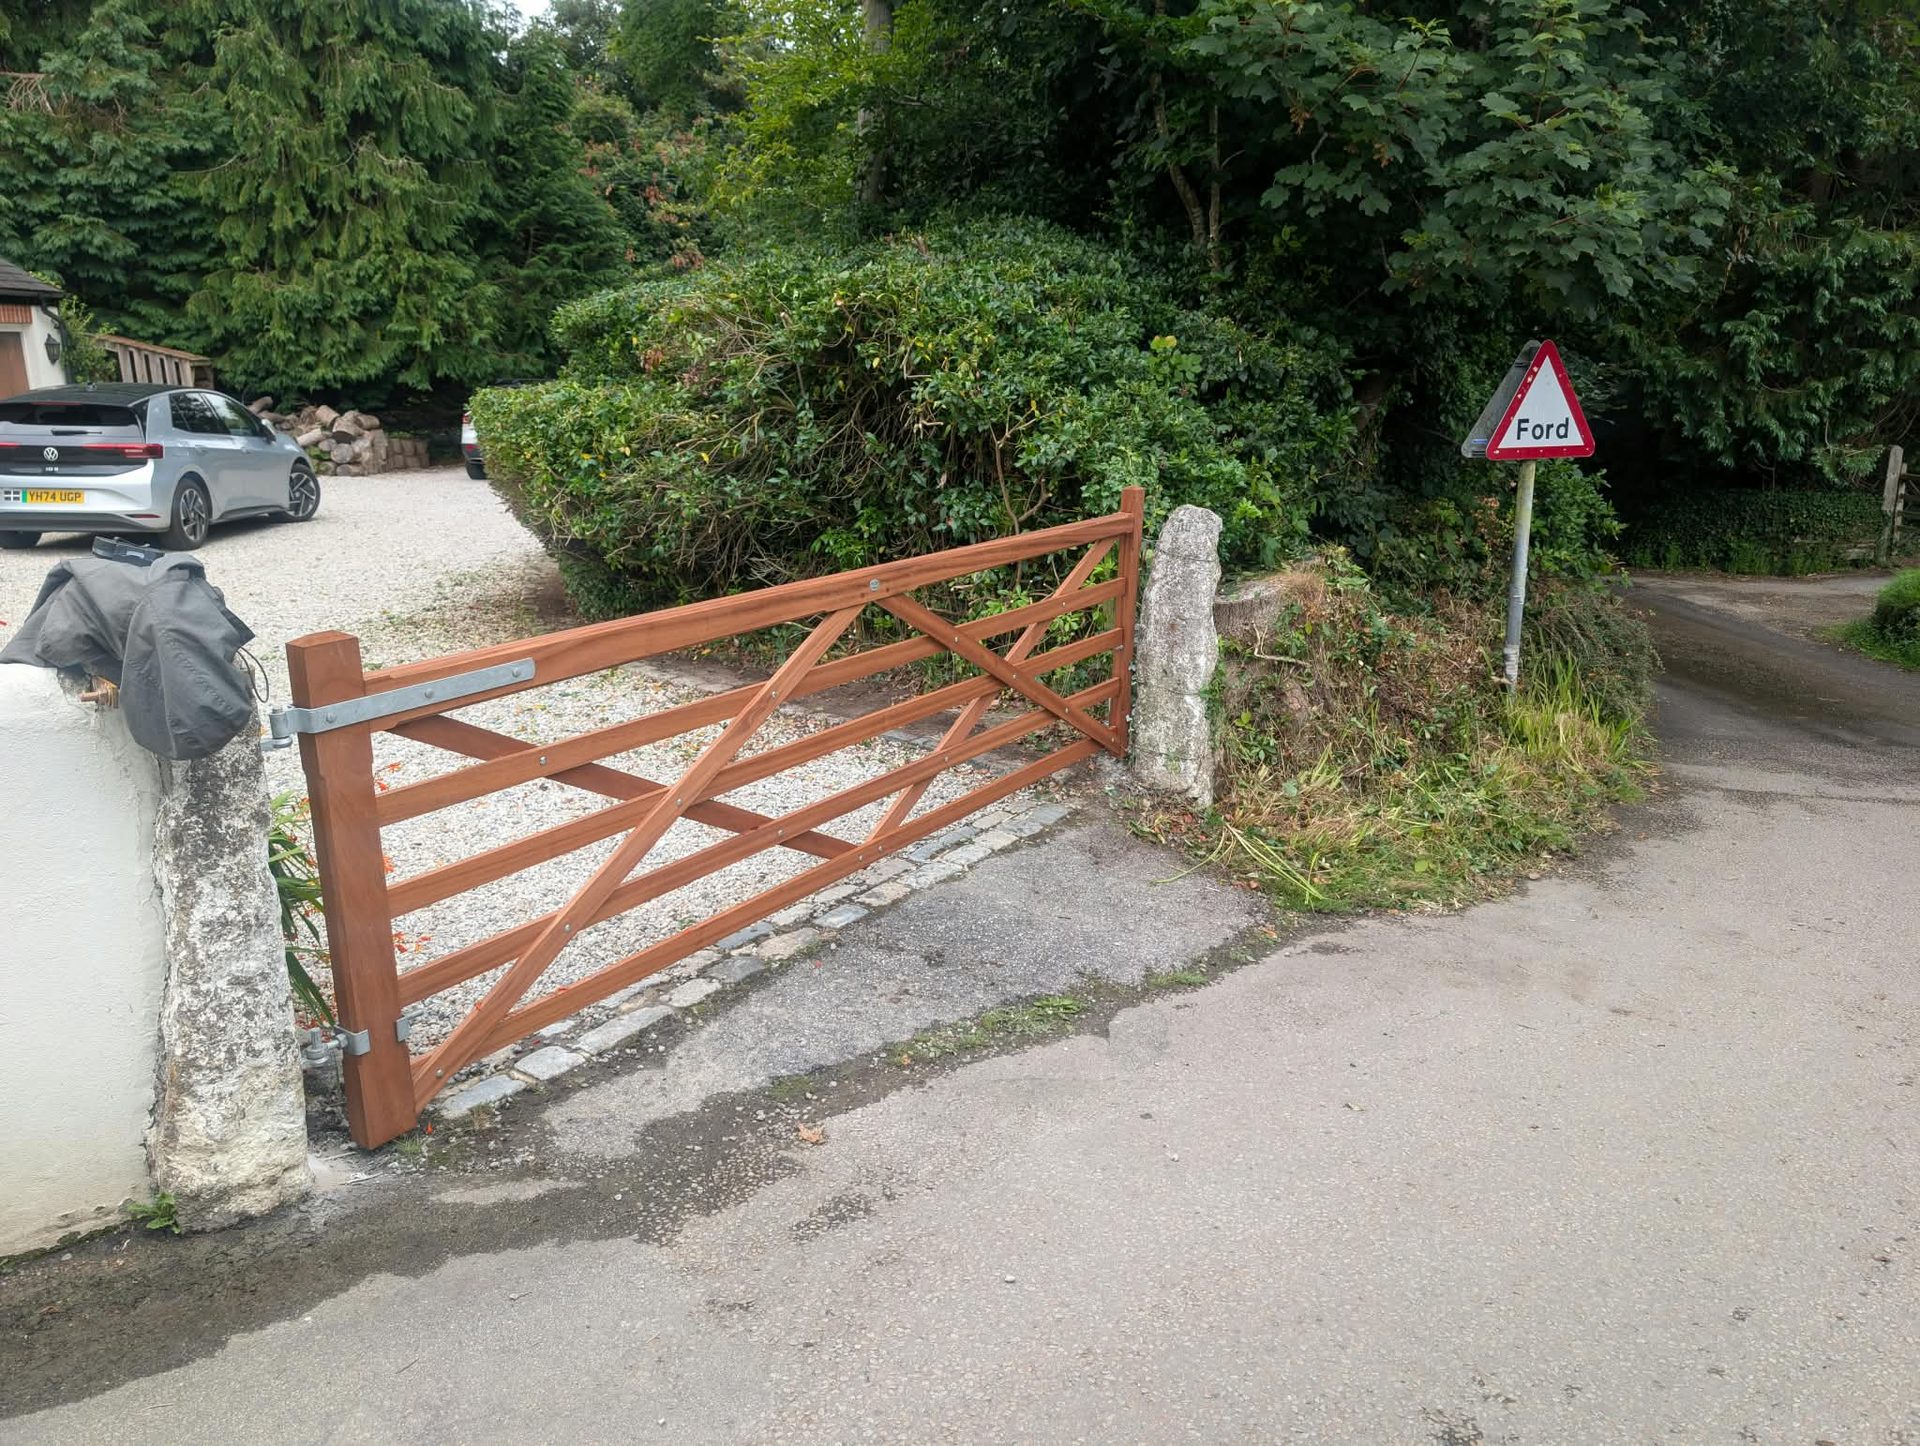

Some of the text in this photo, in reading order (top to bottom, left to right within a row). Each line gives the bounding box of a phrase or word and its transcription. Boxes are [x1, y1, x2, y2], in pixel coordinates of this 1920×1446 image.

[1516, 417, 1569, 440] Ford
[29, 490, 81, 502] YH74 UGP
